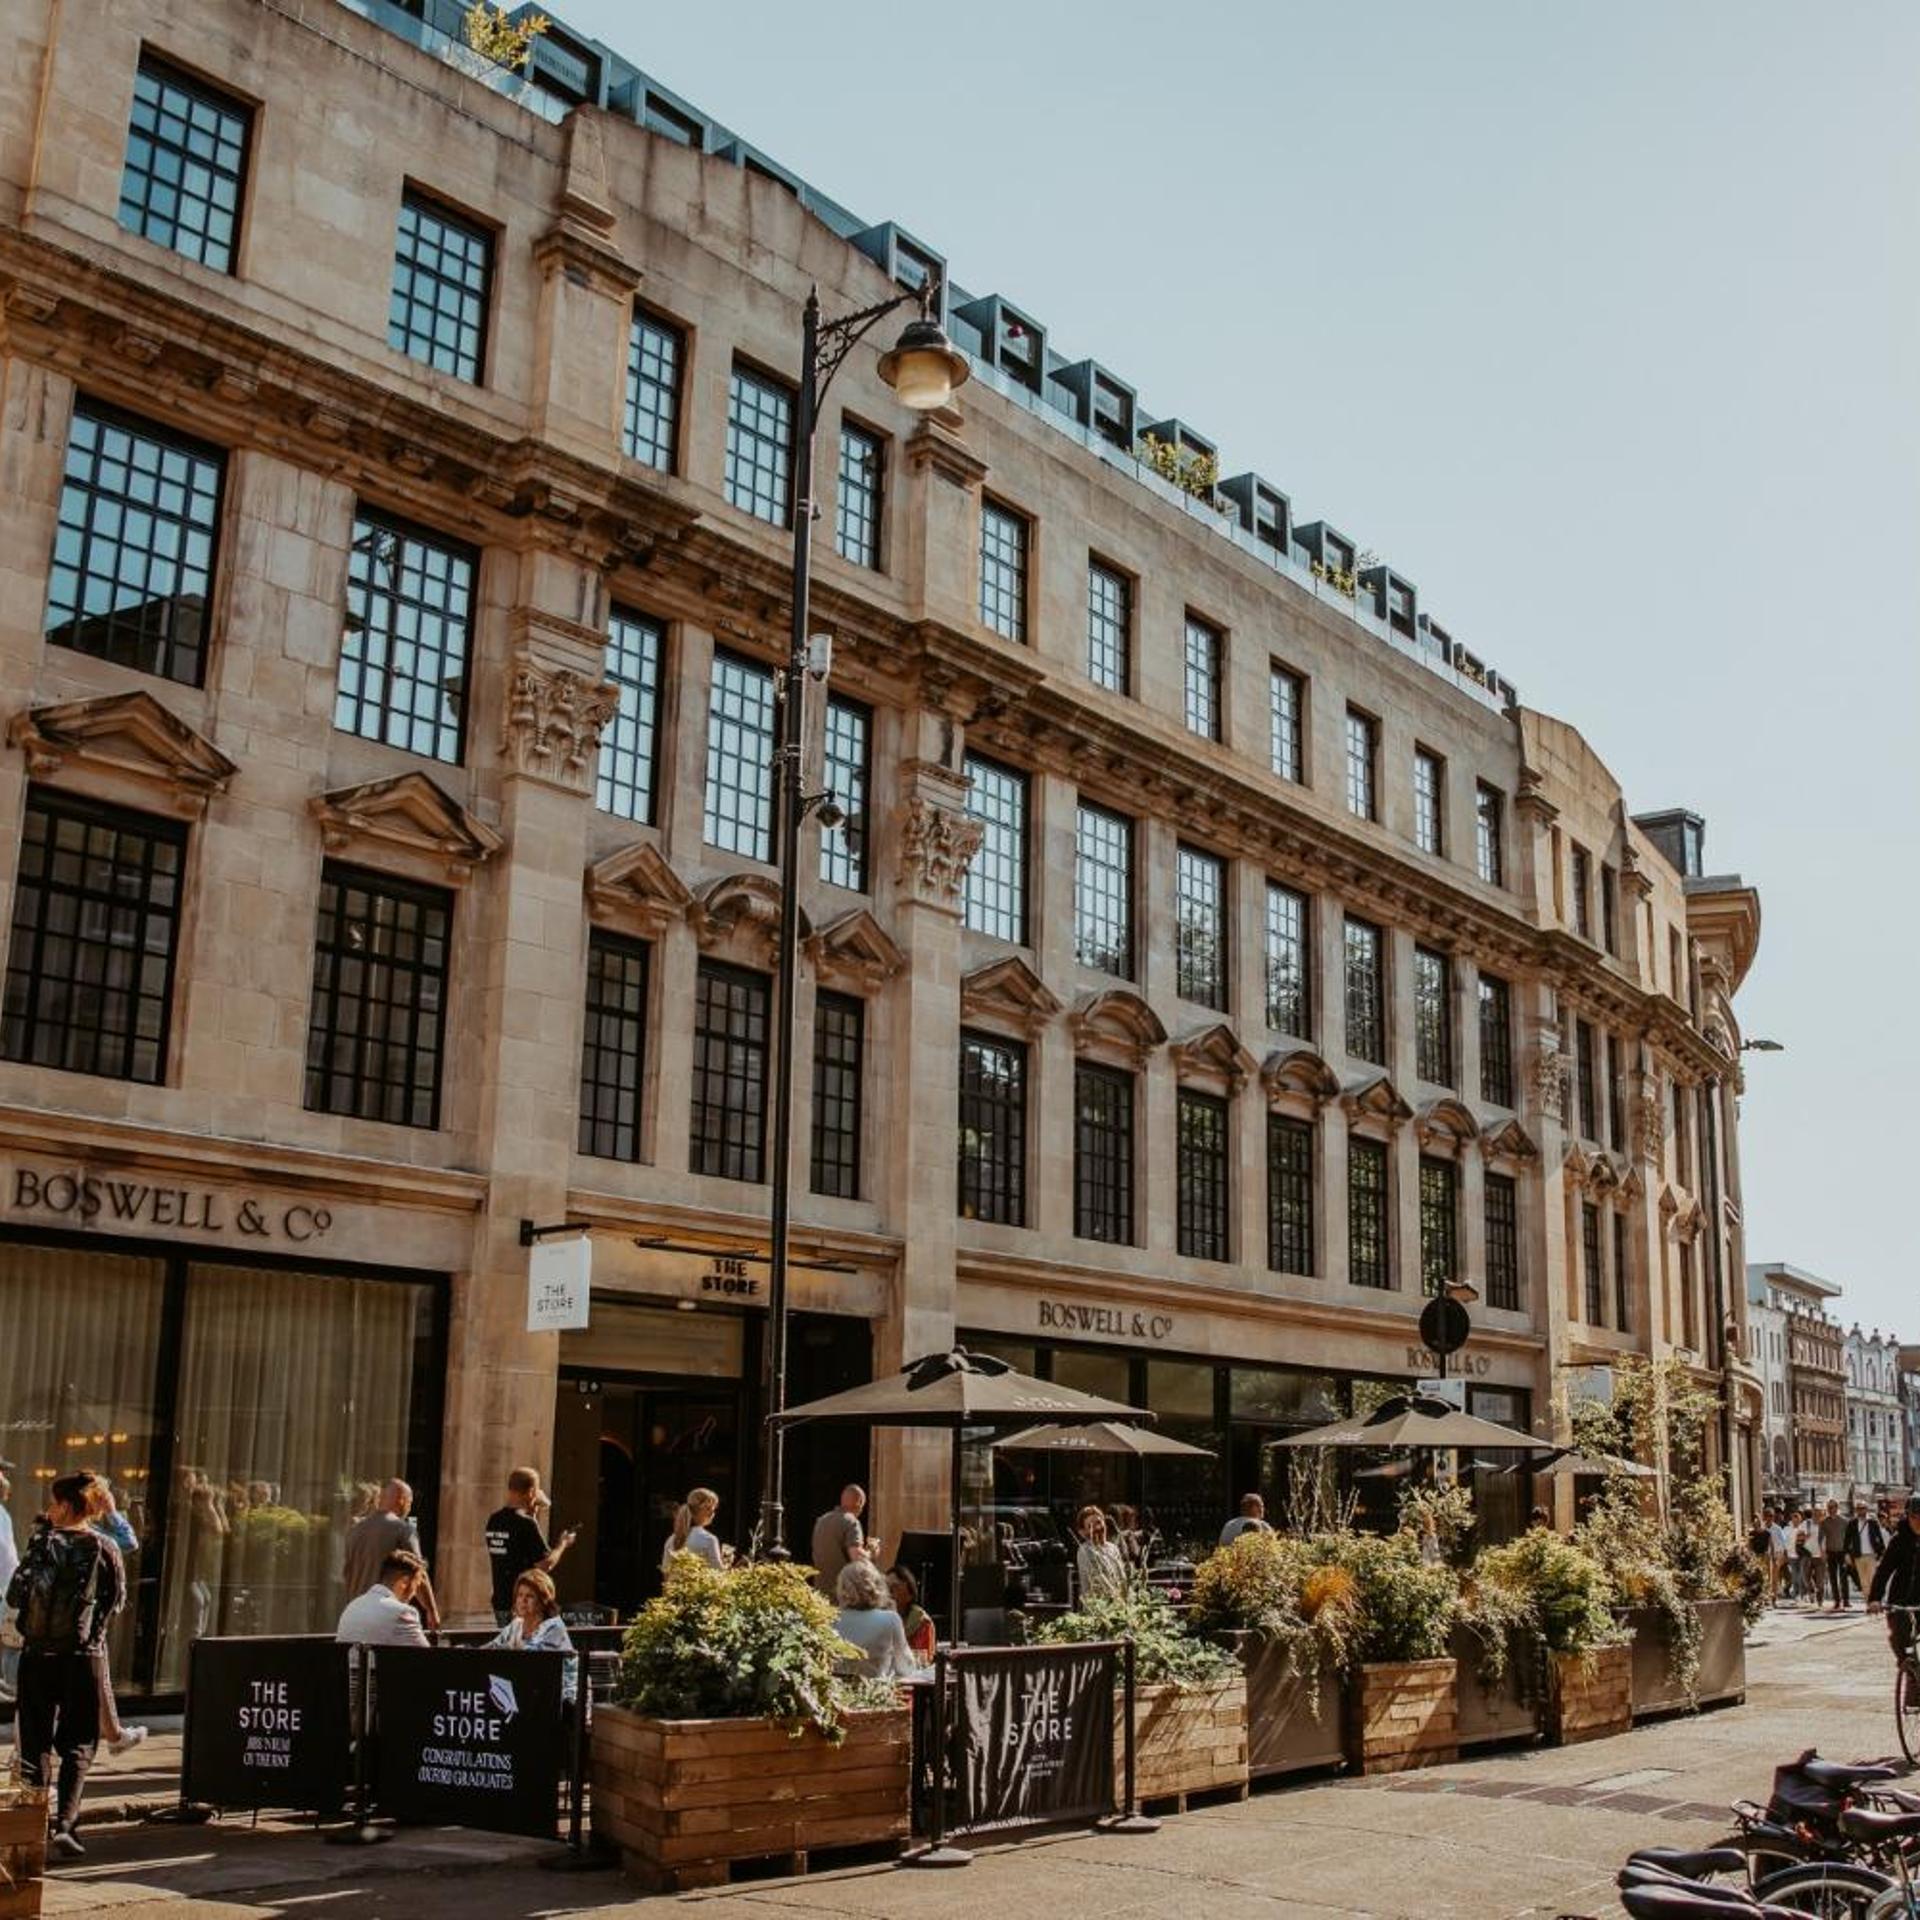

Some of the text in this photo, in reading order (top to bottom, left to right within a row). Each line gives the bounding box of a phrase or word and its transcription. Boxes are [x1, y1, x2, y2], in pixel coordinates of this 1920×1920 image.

[14, 1169, 222, 1231] BOSWELL
[236, 1199, 270, 1236] &
[713, 1259, 748, 1275] THE
[702, 1276, 761, 1296] STORE
[1038, 1300, 1126, 1336] BOSWELL
[1132, 1313, 1146, 1337] &
[251, 1681, 288, 1704] THE
[445, 1689, 486, 1714] THE
[1021, 1691, 1059, 1717] THE
[239, 1706, 302, 1733] STORE
[433, 1714, 501, 1743] STORE
[1008, 1717, 1073, 1747] STORE
[422, 1747, 512, 1771] CONGRATULATIONS
[453, 1770, 513, 1789] GRADUATES
